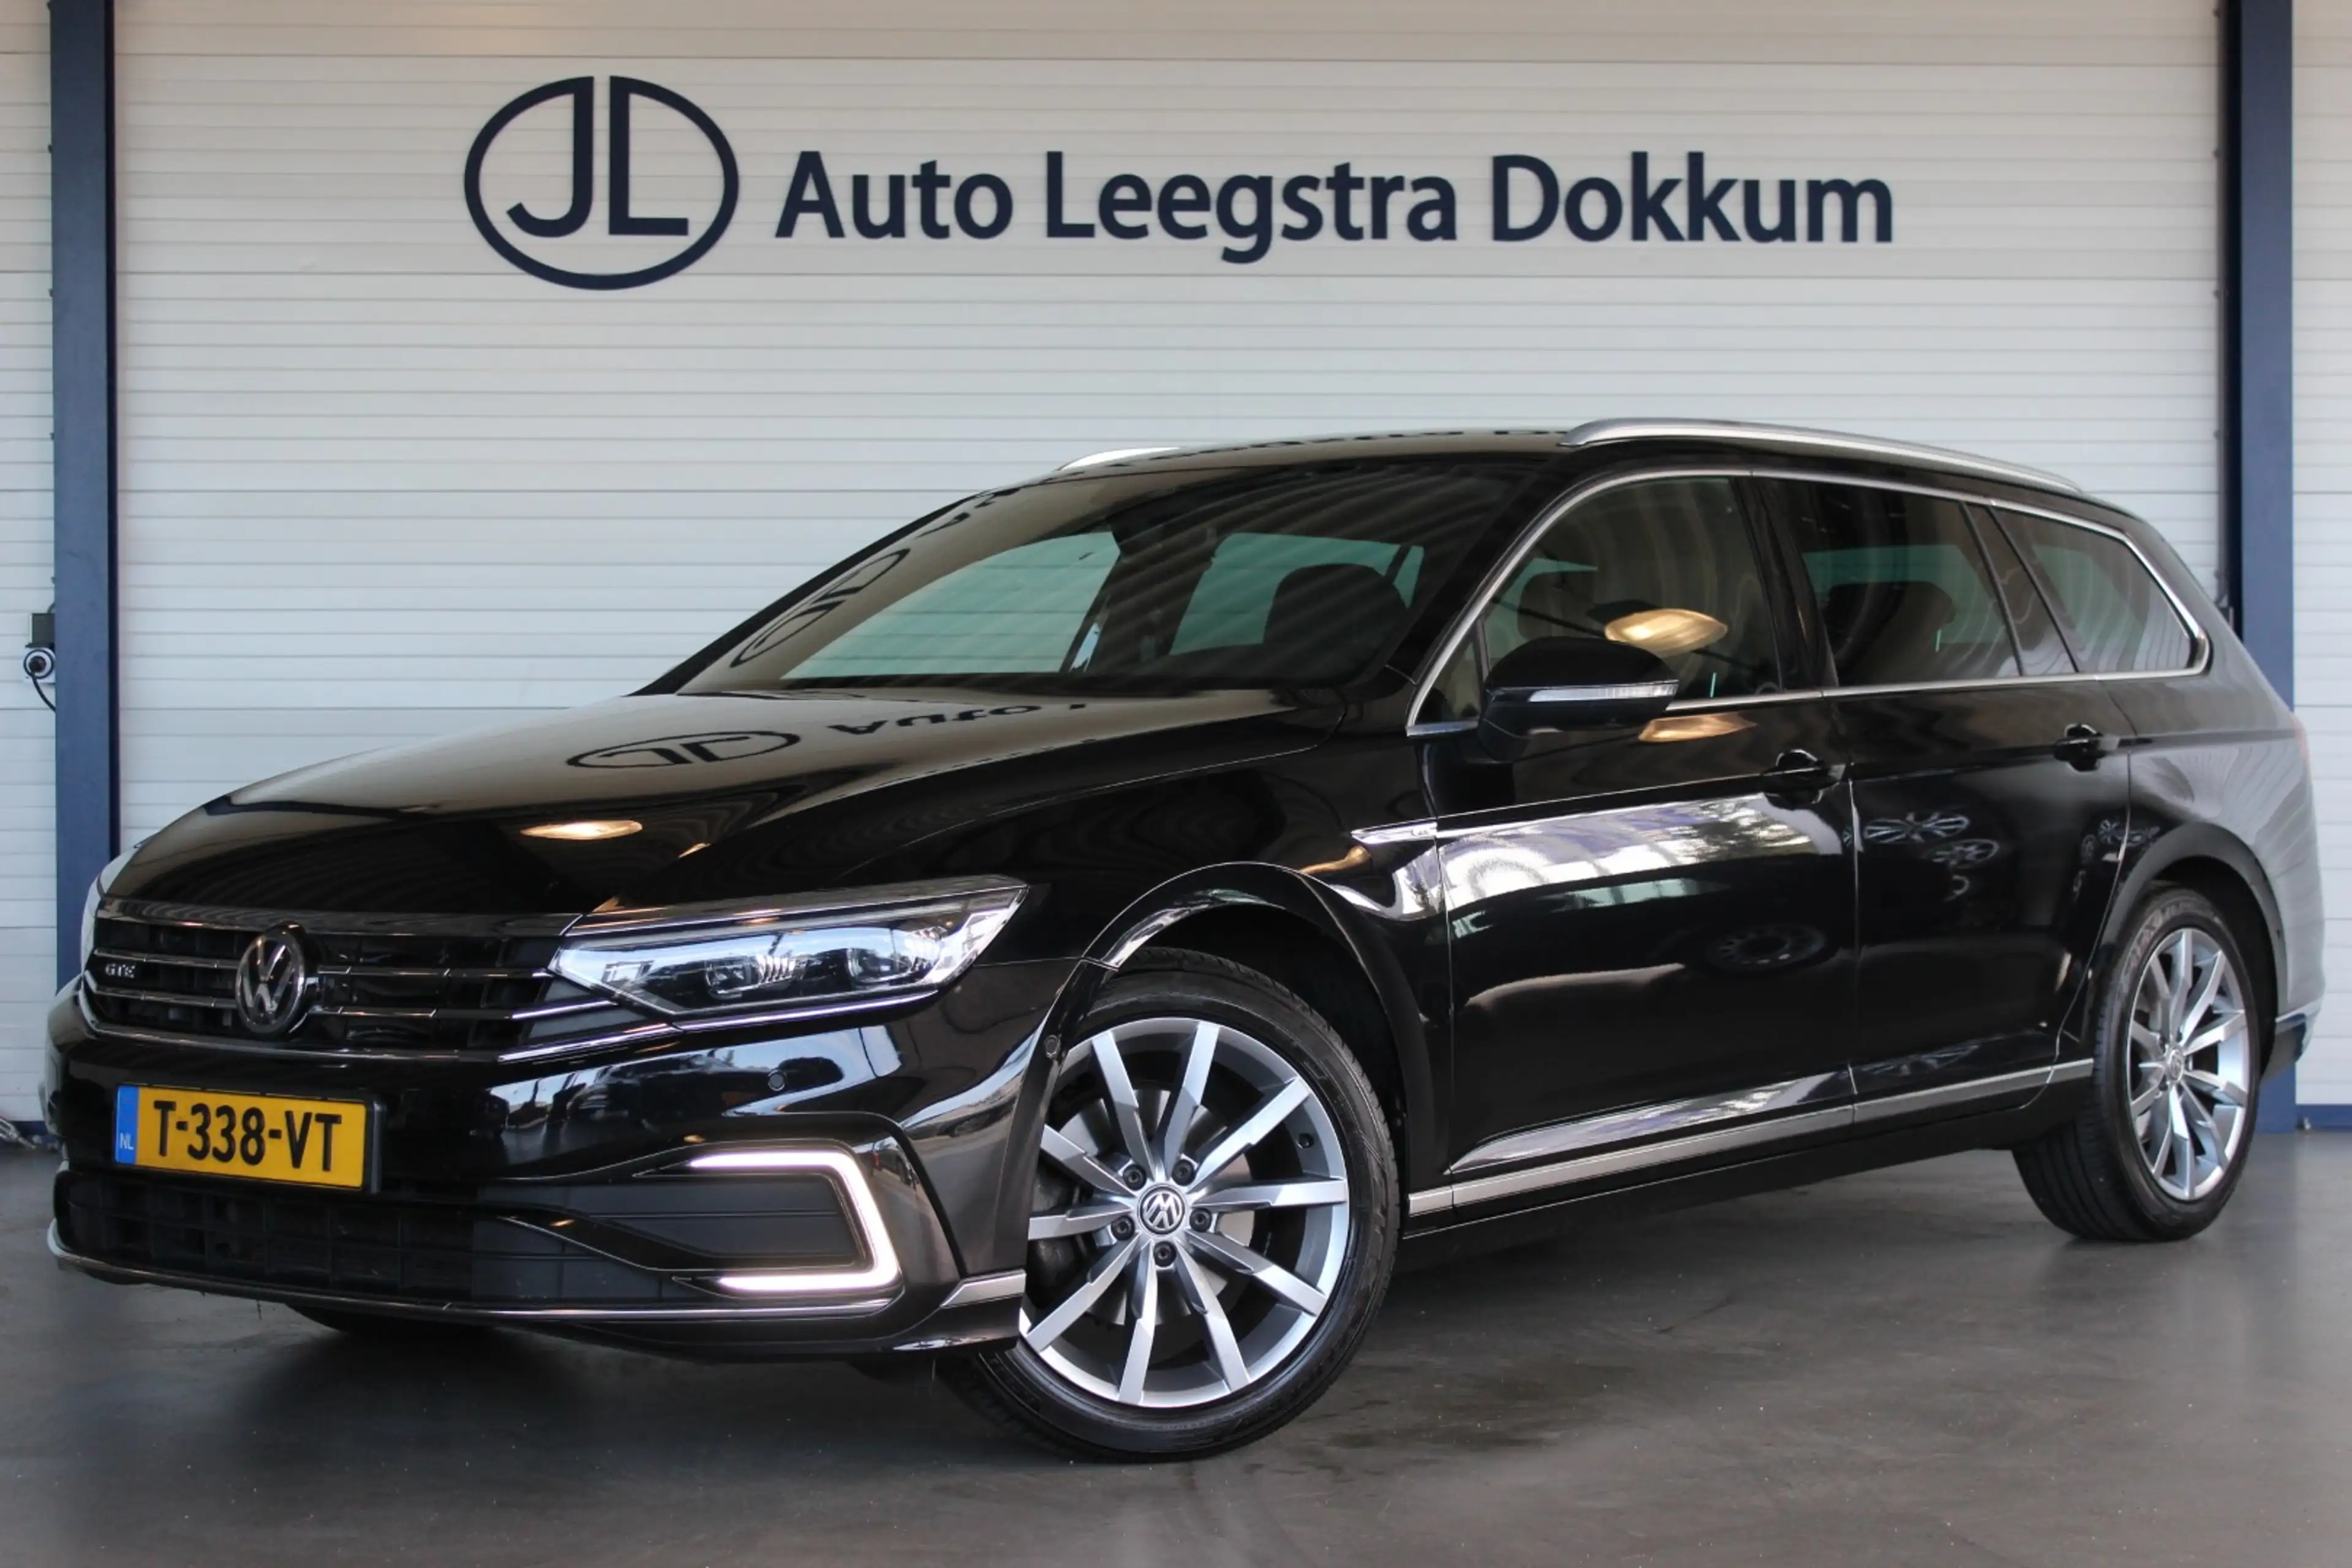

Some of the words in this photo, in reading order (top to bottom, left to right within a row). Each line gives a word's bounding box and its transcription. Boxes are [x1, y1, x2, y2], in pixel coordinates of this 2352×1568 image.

[775, 151, 1014, 239] Auto
[1046, 151, 1457, 264] Leegstra
[1492, 151, 1893, 243] Dokkum
[120, 1132, 135, 1150] NL
[153, 1100, 342, 1172] T-338-VT
